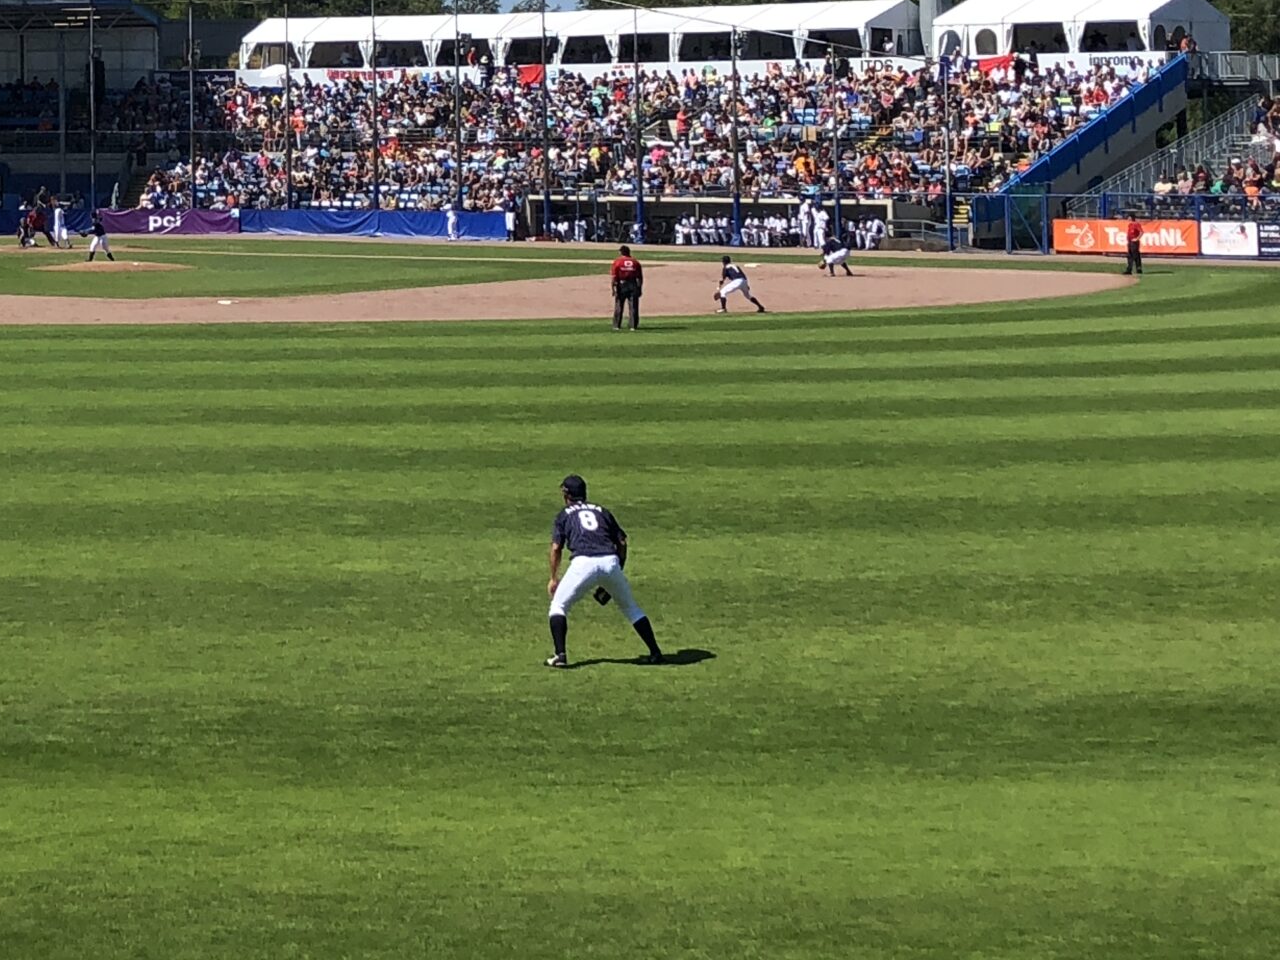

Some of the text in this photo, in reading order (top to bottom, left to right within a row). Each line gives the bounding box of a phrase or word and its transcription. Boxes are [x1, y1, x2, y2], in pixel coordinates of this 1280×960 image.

[149, 211, 181, 231] pci
[1104, 227, 1186, 246] TemNL
[578, 510, 599, 531] 8
